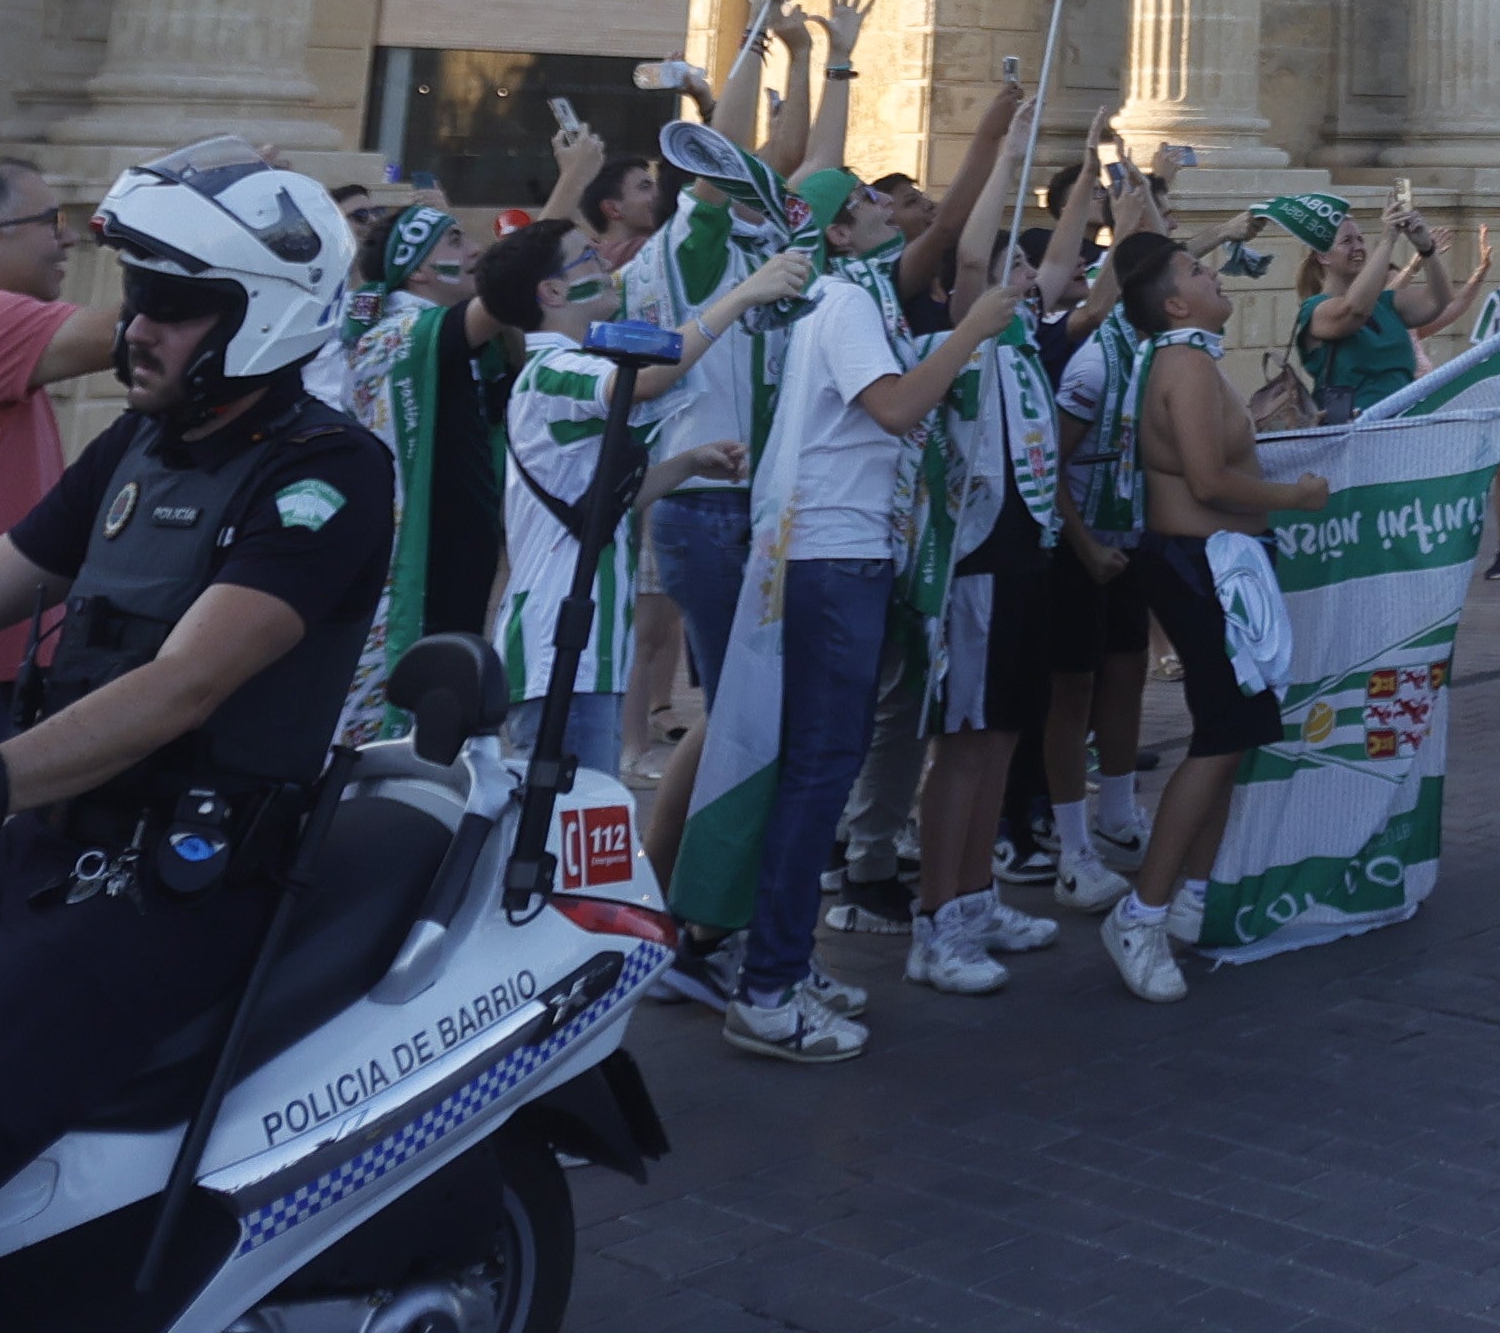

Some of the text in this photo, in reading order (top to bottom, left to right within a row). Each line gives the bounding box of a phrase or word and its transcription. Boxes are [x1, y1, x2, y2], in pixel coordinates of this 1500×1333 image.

[590, 823, 626, 853] 112
[262, 970, 537, 1146] POLICIA DE BARRIO
